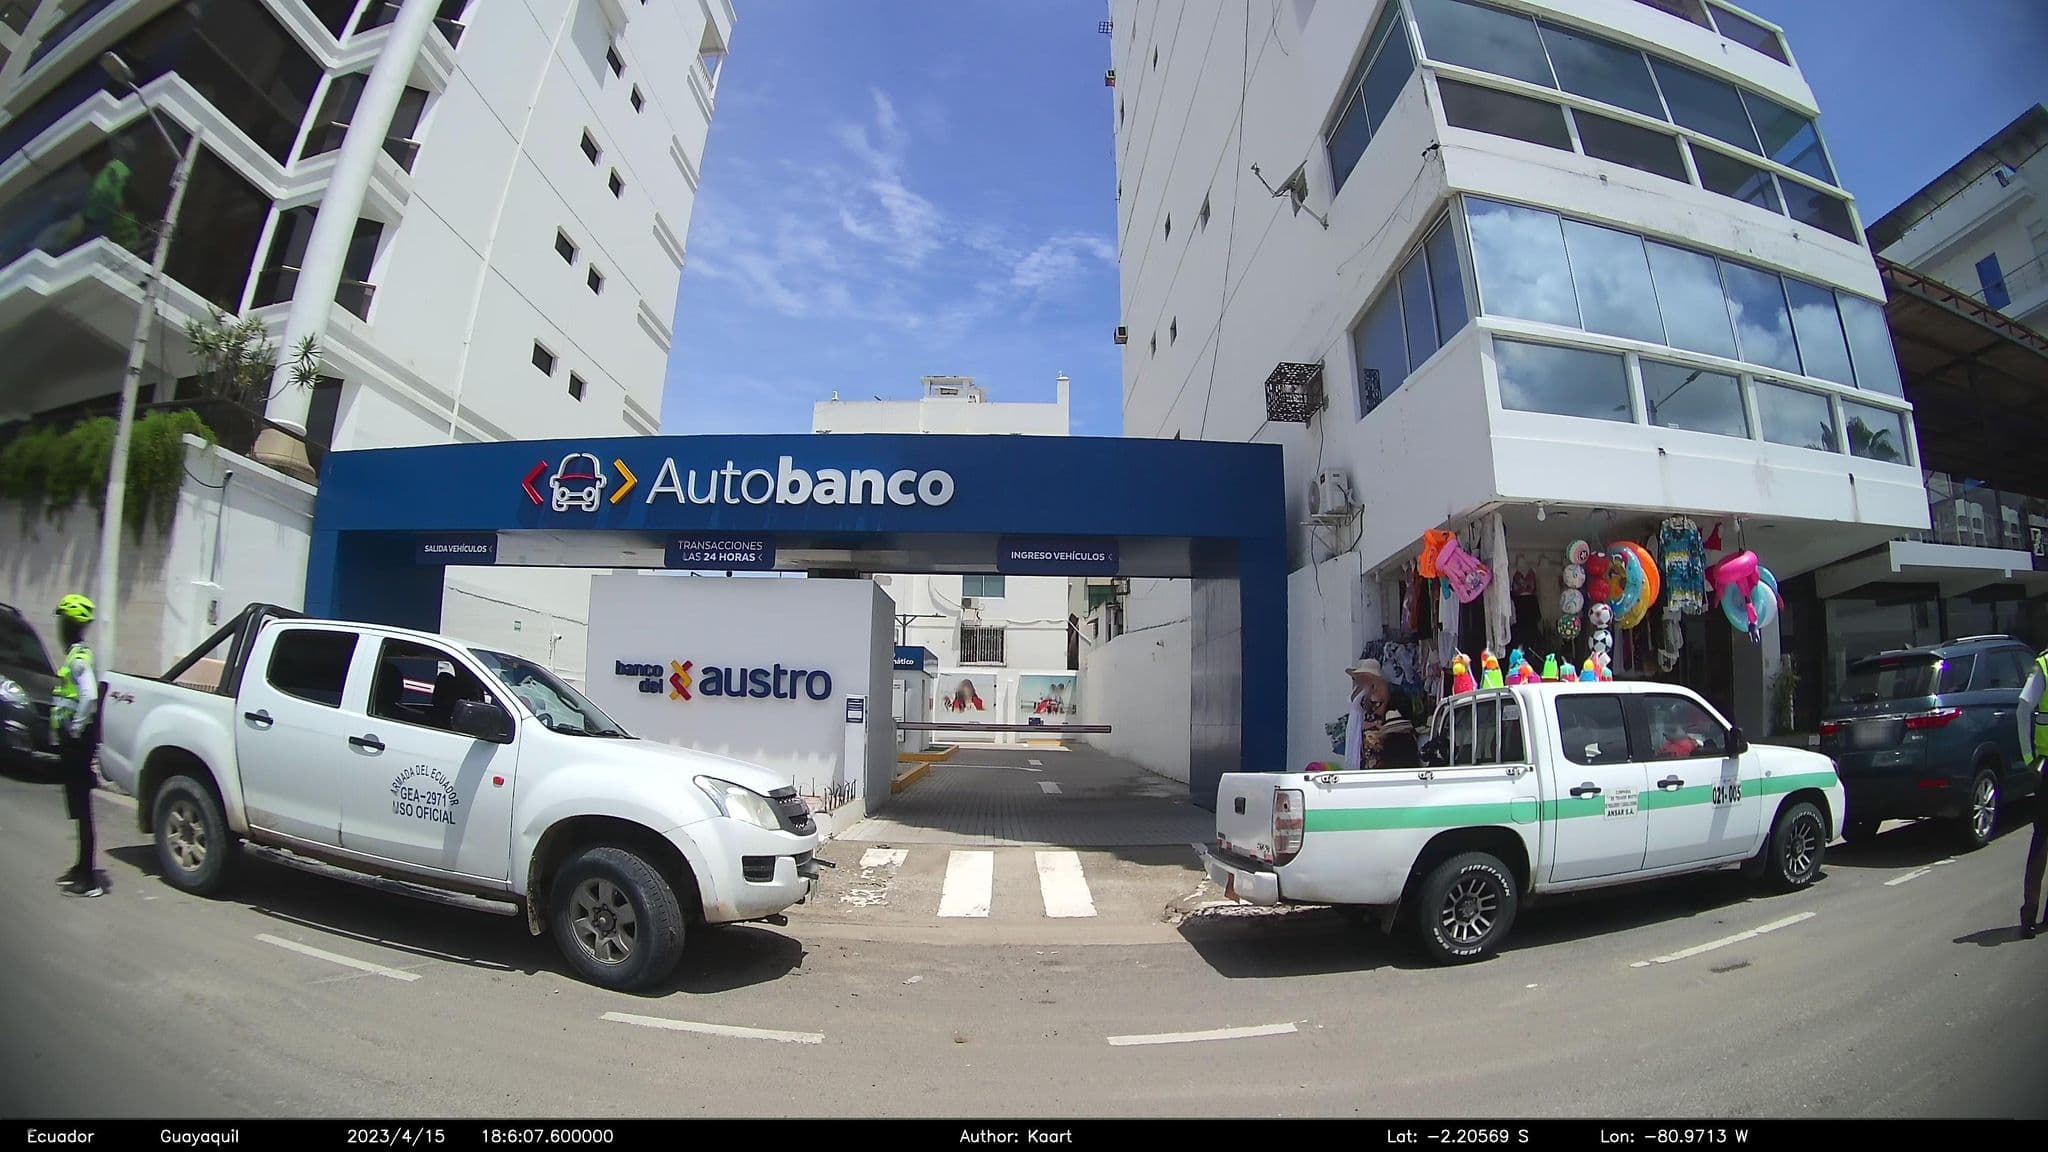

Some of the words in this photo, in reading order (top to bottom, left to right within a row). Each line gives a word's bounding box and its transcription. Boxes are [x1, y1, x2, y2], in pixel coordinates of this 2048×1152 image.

[646, 455, 955, 507] Autobanco
[424, 544, 448, 553] SALIDA
[448, 543, 488, 553] VEHÍCULOS
[678, 540, 763, 551] TRANSACCIONES
[683, 552, 702, 561] LAS
[703, 552, 717, 561] 24
[719, 552, 756, 562] HORAS
[1011, 551, 1052, 560] INGRESO
[1053, 550, 1105, 561] VEHÍCULOS
[615, 660, 664, 677] banco
[638, 677, 664, 694] del
[699, 663, 833, 701] austro
[390, 766, 416, 797] ARMADA
[415, 764, 429, 777] DEL
[430, 768, 459, 806] ECUADOR
[400, 786, 447, 807] GEA-2971
[392, 800, 413, 817] USO
[415, 805, 456, 825] OFICIAL
